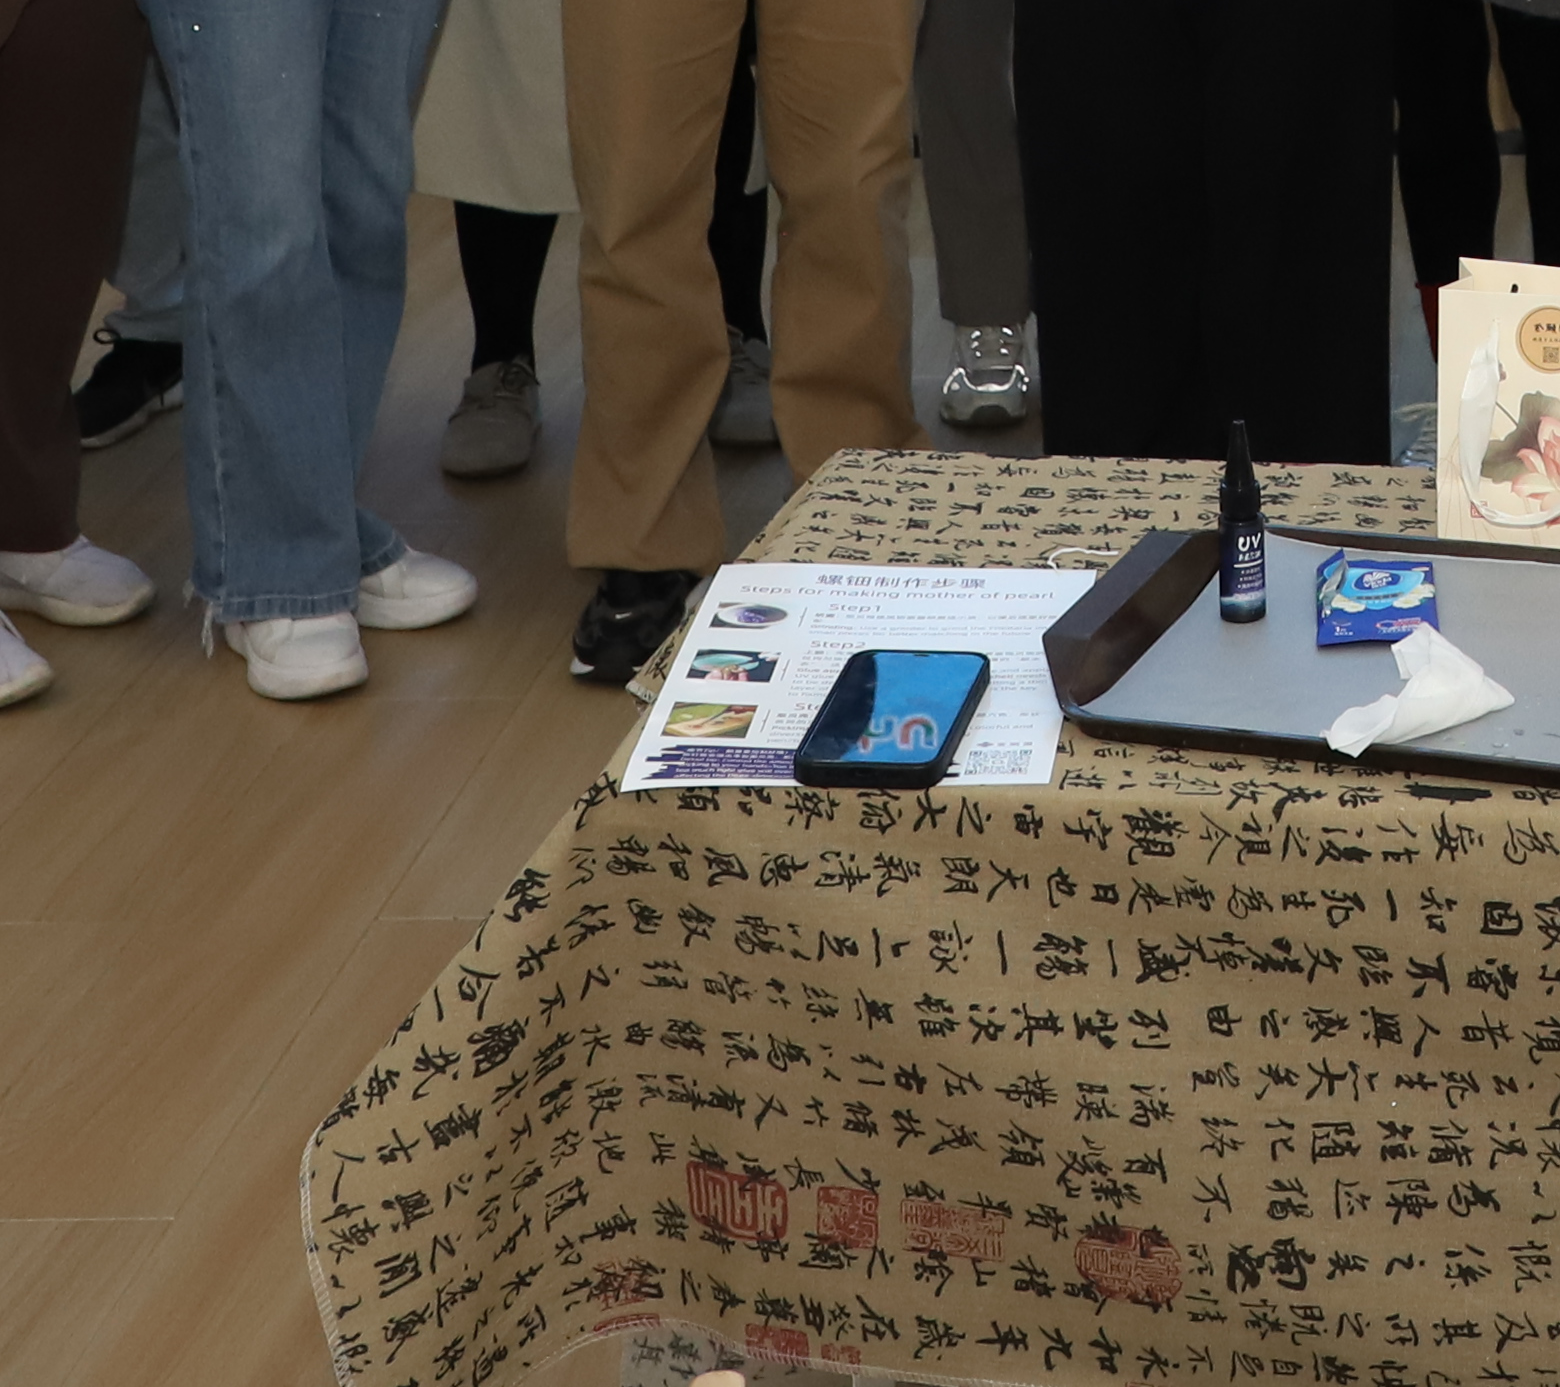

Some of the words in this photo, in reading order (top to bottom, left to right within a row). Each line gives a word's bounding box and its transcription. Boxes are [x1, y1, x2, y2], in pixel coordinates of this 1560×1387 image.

[1237, 532, 1262, 553] UV
[815, 573, 987, 590] 螺钿制作步骤
[739, 584, 794, 597] Steps
[797, 586, 826, 597] for
[829, 588, 900, 600] making
[904, 590, 977, 600] mother
[980, 590, 1001, 600] of
[1004, 590, 1055, 602] pearl
[828, 602, 882, 615] Step1
[810, 639, 867, 651] Step2
